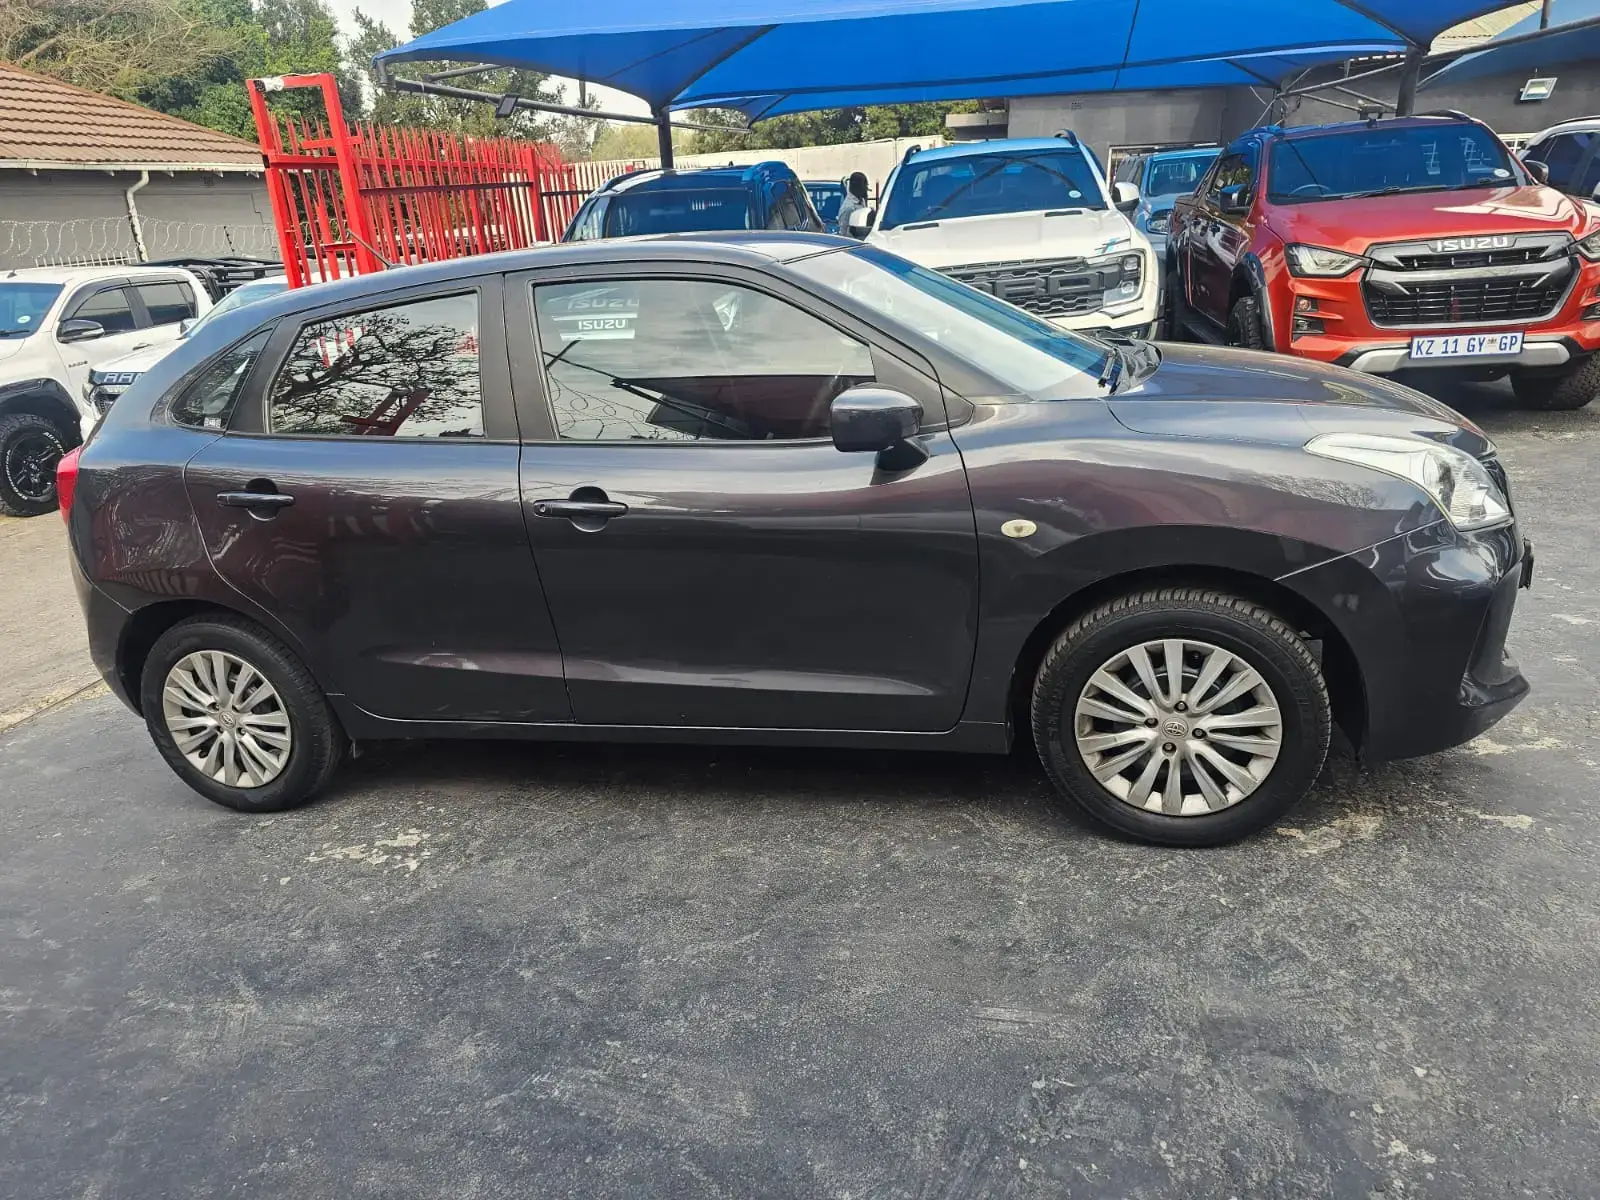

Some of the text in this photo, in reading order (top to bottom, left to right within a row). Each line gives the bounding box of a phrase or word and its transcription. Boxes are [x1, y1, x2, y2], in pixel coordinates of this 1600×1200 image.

[1436, 236, 1508, 252] ISUZU
[577, 319, 626, 330] ISUZU
[1415, 335, 1518, 356] KZ 11 GY GP
